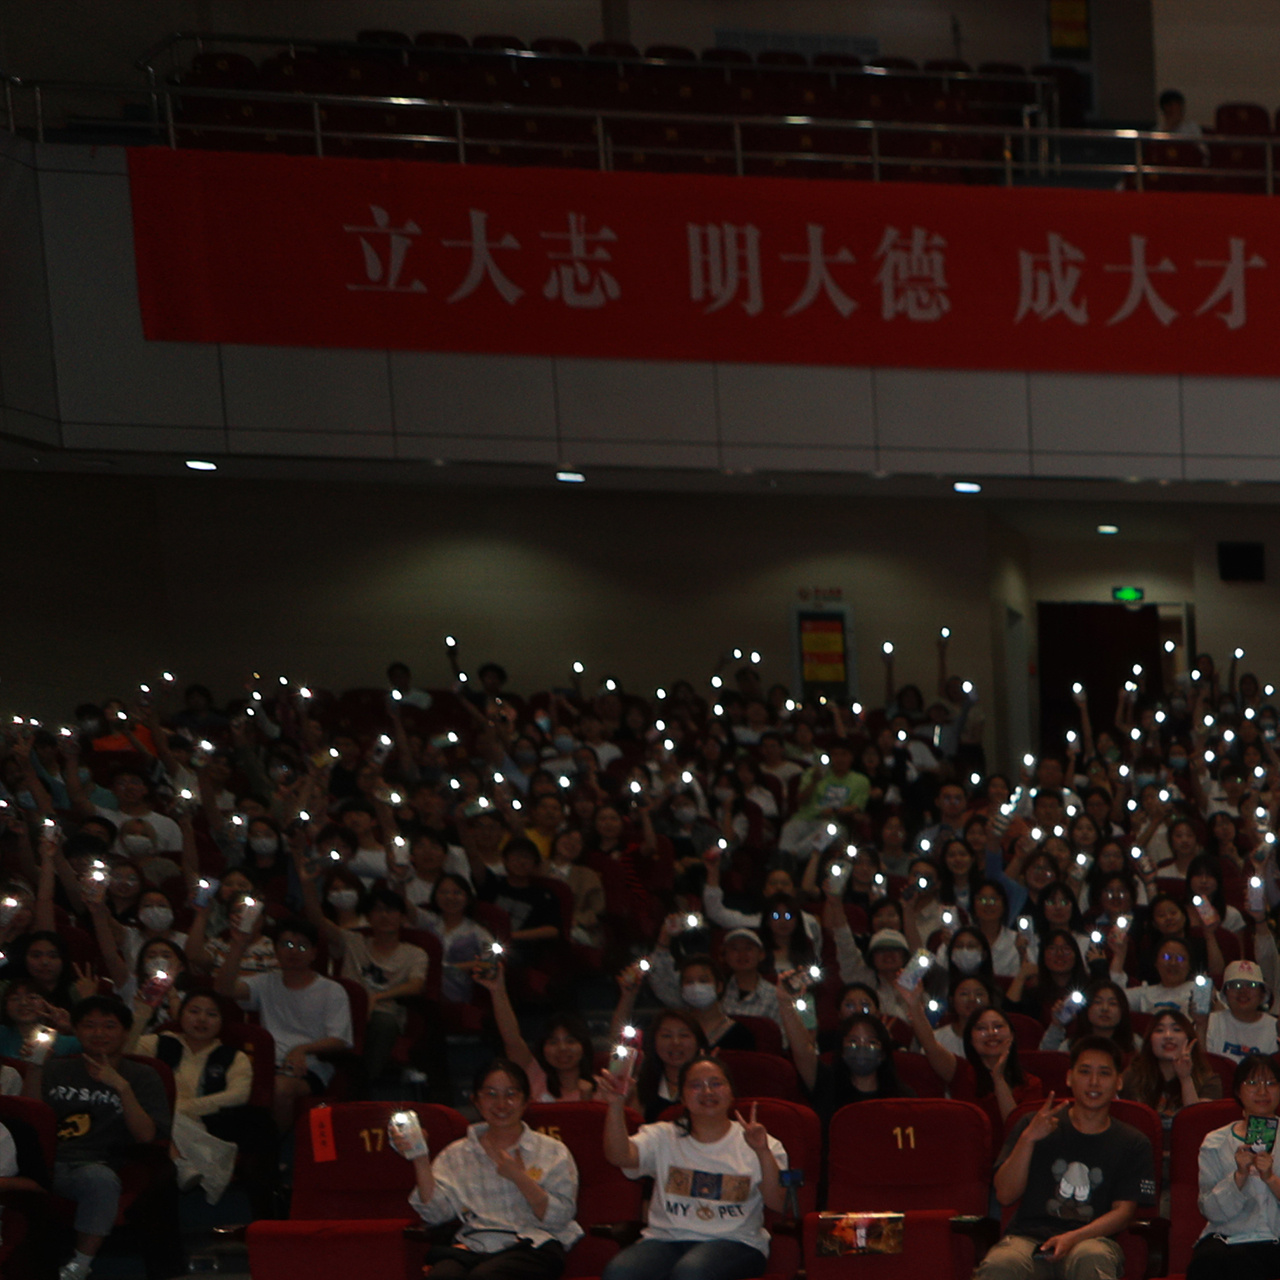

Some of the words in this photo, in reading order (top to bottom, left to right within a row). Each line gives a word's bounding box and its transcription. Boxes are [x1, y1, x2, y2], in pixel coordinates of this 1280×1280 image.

[343, 204, 622, 310] 立大志
[686, 222, 952, 324] 明大德
[1014, 231, 1268, 332] 成大才
[359, 1128, 386, 1153] 17
[892, 1126, 917, 1149] 11
[665, 1200, 691, 1217] MY
[717, 1204, 745, 1219] PET
